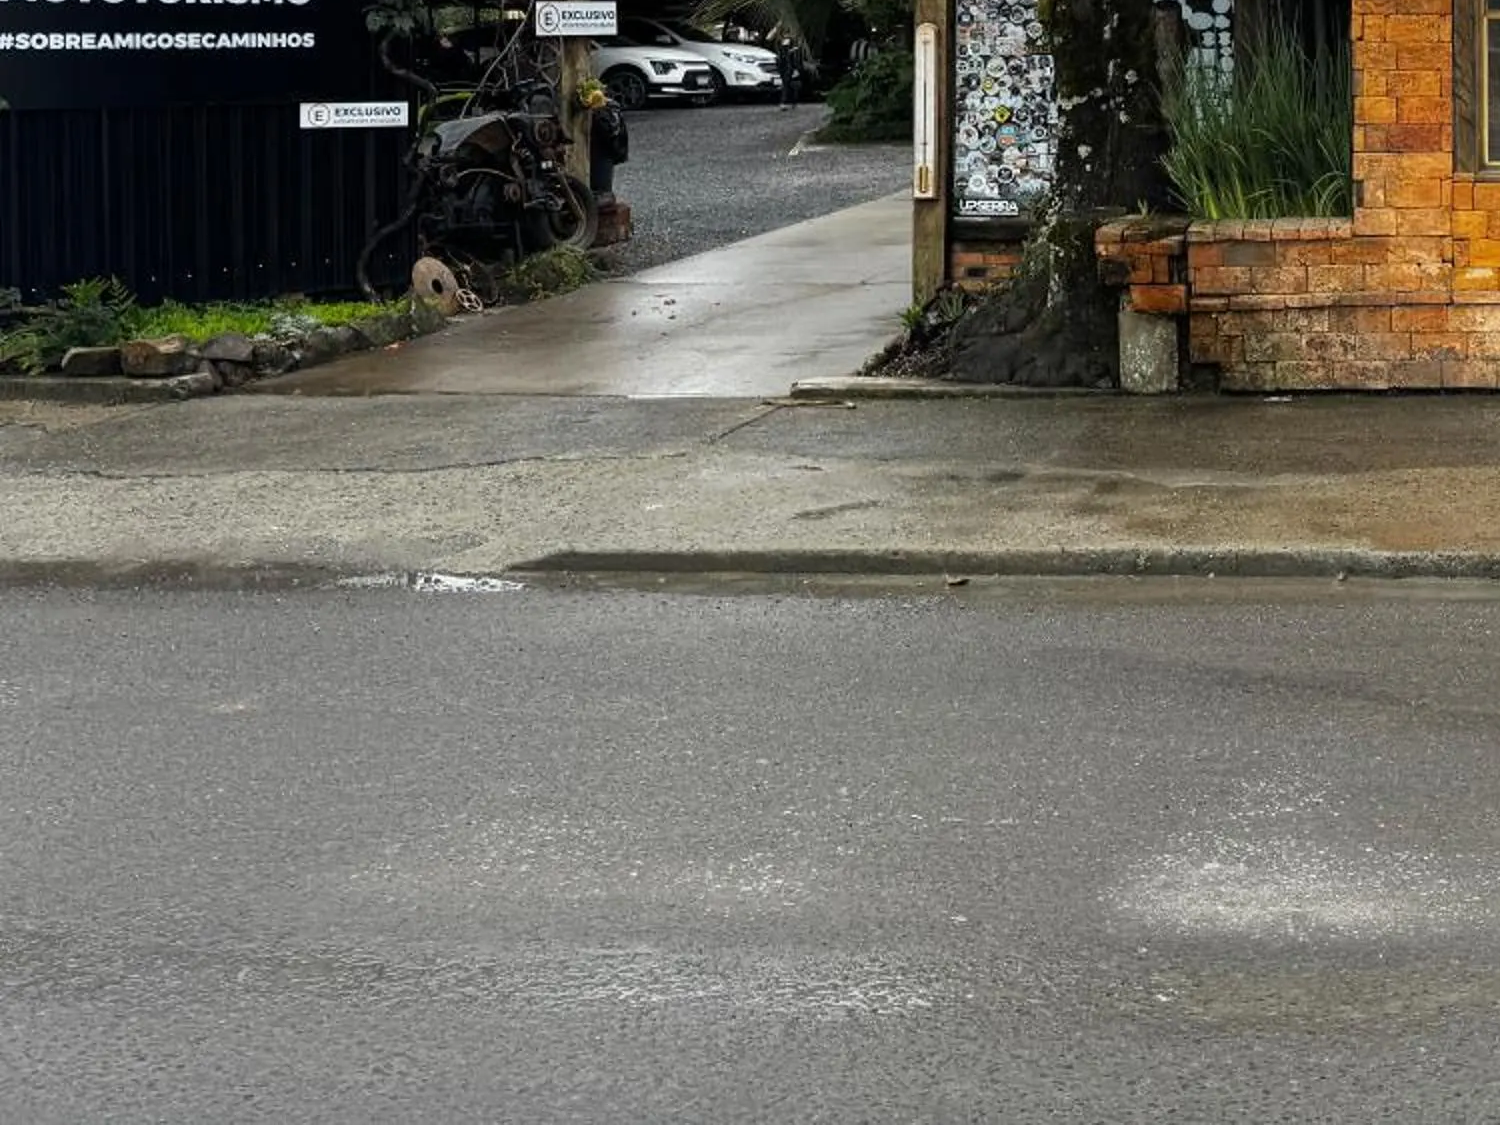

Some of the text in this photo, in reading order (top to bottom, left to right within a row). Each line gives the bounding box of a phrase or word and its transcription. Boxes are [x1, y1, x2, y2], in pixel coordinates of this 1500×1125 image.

[561, 10, 615, 20] EXCLUSIVO
[0, 32, 315, 50] #SOBREAMIGOSECAMINHOS
[334, 106, 402, 117] EXCLUSIVO
